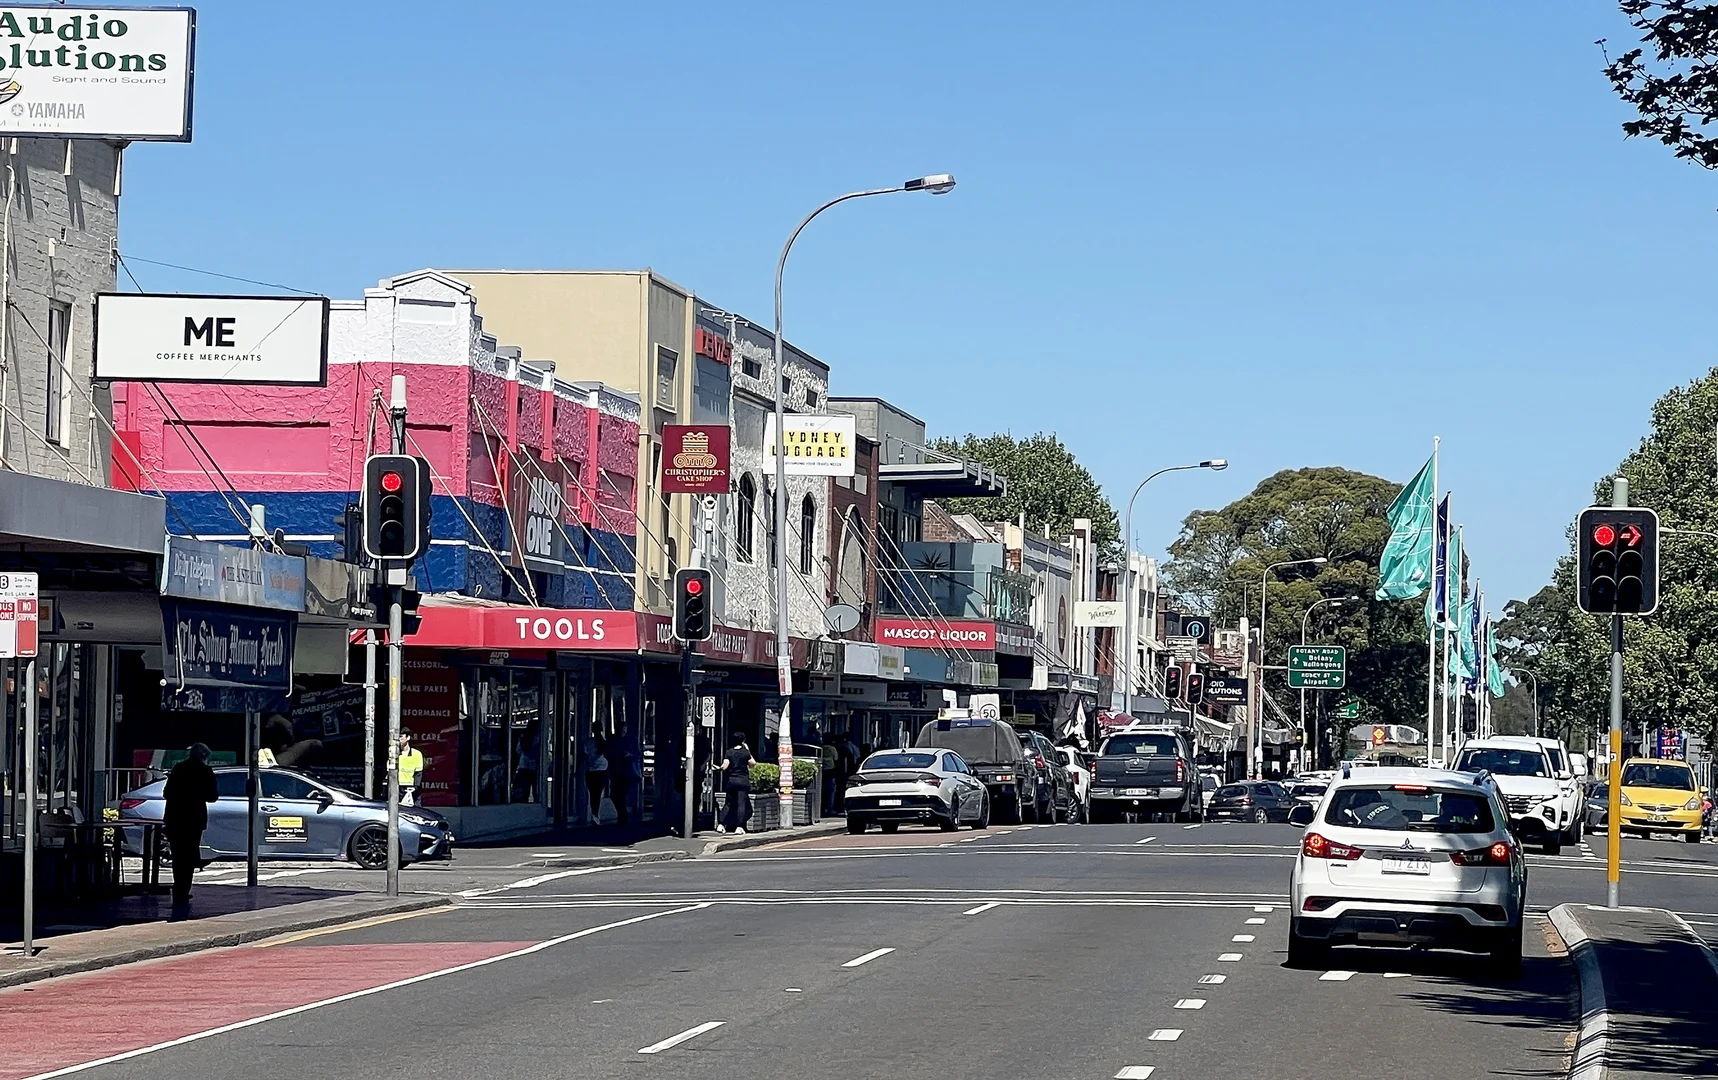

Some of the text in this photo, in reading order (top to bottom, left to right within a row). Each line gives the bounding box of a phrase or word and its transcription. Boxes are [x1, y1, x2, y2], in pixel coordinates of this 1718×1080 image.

[0, 12, 128, 42] Audio
[0, 44, 167, 72] lutions
[52, 75, 87, 84] Sight
[91, 76, 117, 84] and
[28, 102, 86, 120] YAMAHA
[184, 316, 236, 347] ME
[156, 352, 262, 362] COFFEE MERCHANTS
[788, 431, 841, 443] YDNEY
[772, 445, 846, 458] LUGGAGE
[665, 468, 726, 476] CHRISTOPHER'S
[528, 476, 561, 518] AUTO
[526, 515, 553, 556] ONE
[22, 602, 32, 611] NO
[516, 617, 606, 640] TOOLS
[884, 627, 987, 642] MASCOT LIQUOR
[490, 651, 510, 659] AUTO
[402, 685, 448, 693] PARE PARTS
[291, 697, 365, 716] MEMBERSHIP CAR
[983, 709, 996, 718] 50
[421, 782, 449, 790] TRAVEL
